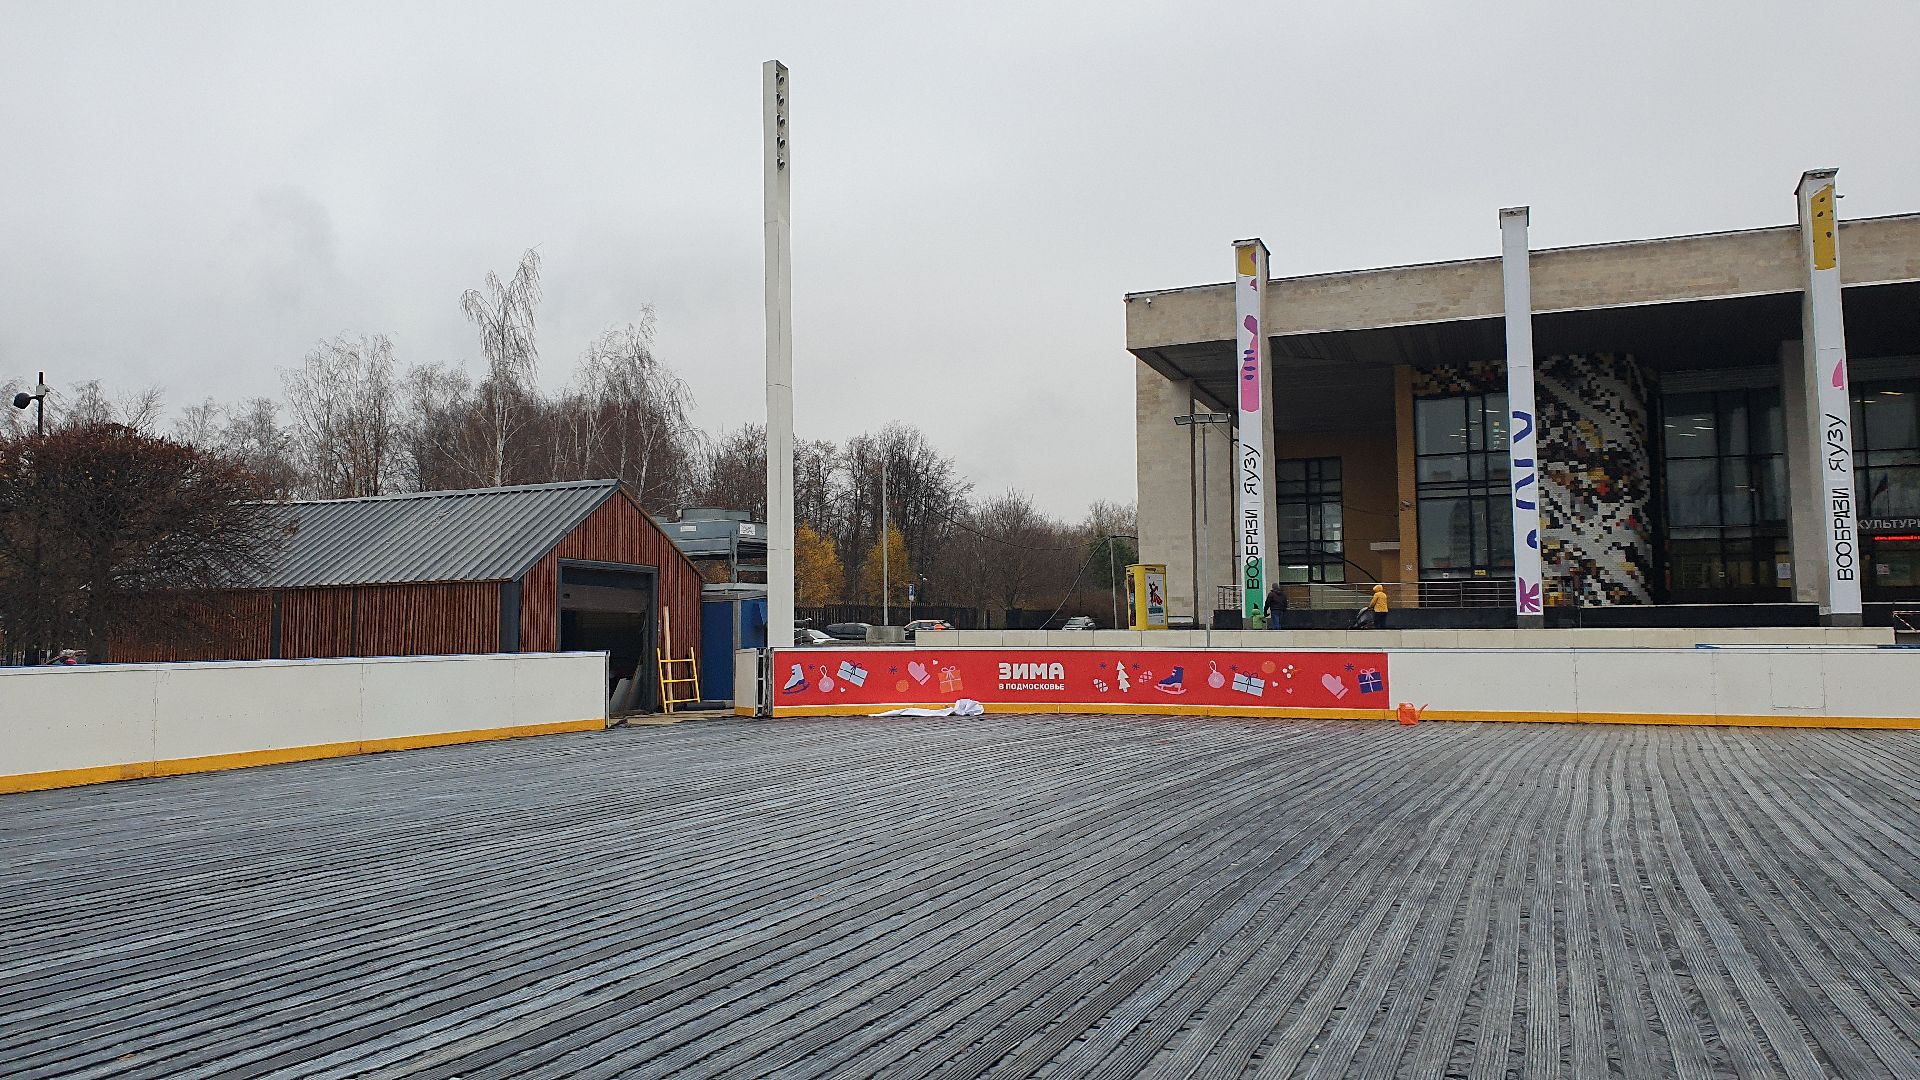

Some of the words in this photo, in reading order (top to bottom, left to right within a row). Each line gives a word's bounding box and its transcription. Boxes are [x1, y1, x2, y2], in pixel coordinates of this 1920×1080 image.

[1243, 443, 1261, 496] ЯУЗУ
[1824, 413, 1849, 473] ЯУЗУ
[1244, 509, 1260, 590] ВООБРАЗИ
[1831, 487, 1854, 581] ВООБРАЗИ
[998, 662, 1065, 680] ЗИМА
[1005, 683, 1065, 691] ПОДМОСКОВЬЕ
